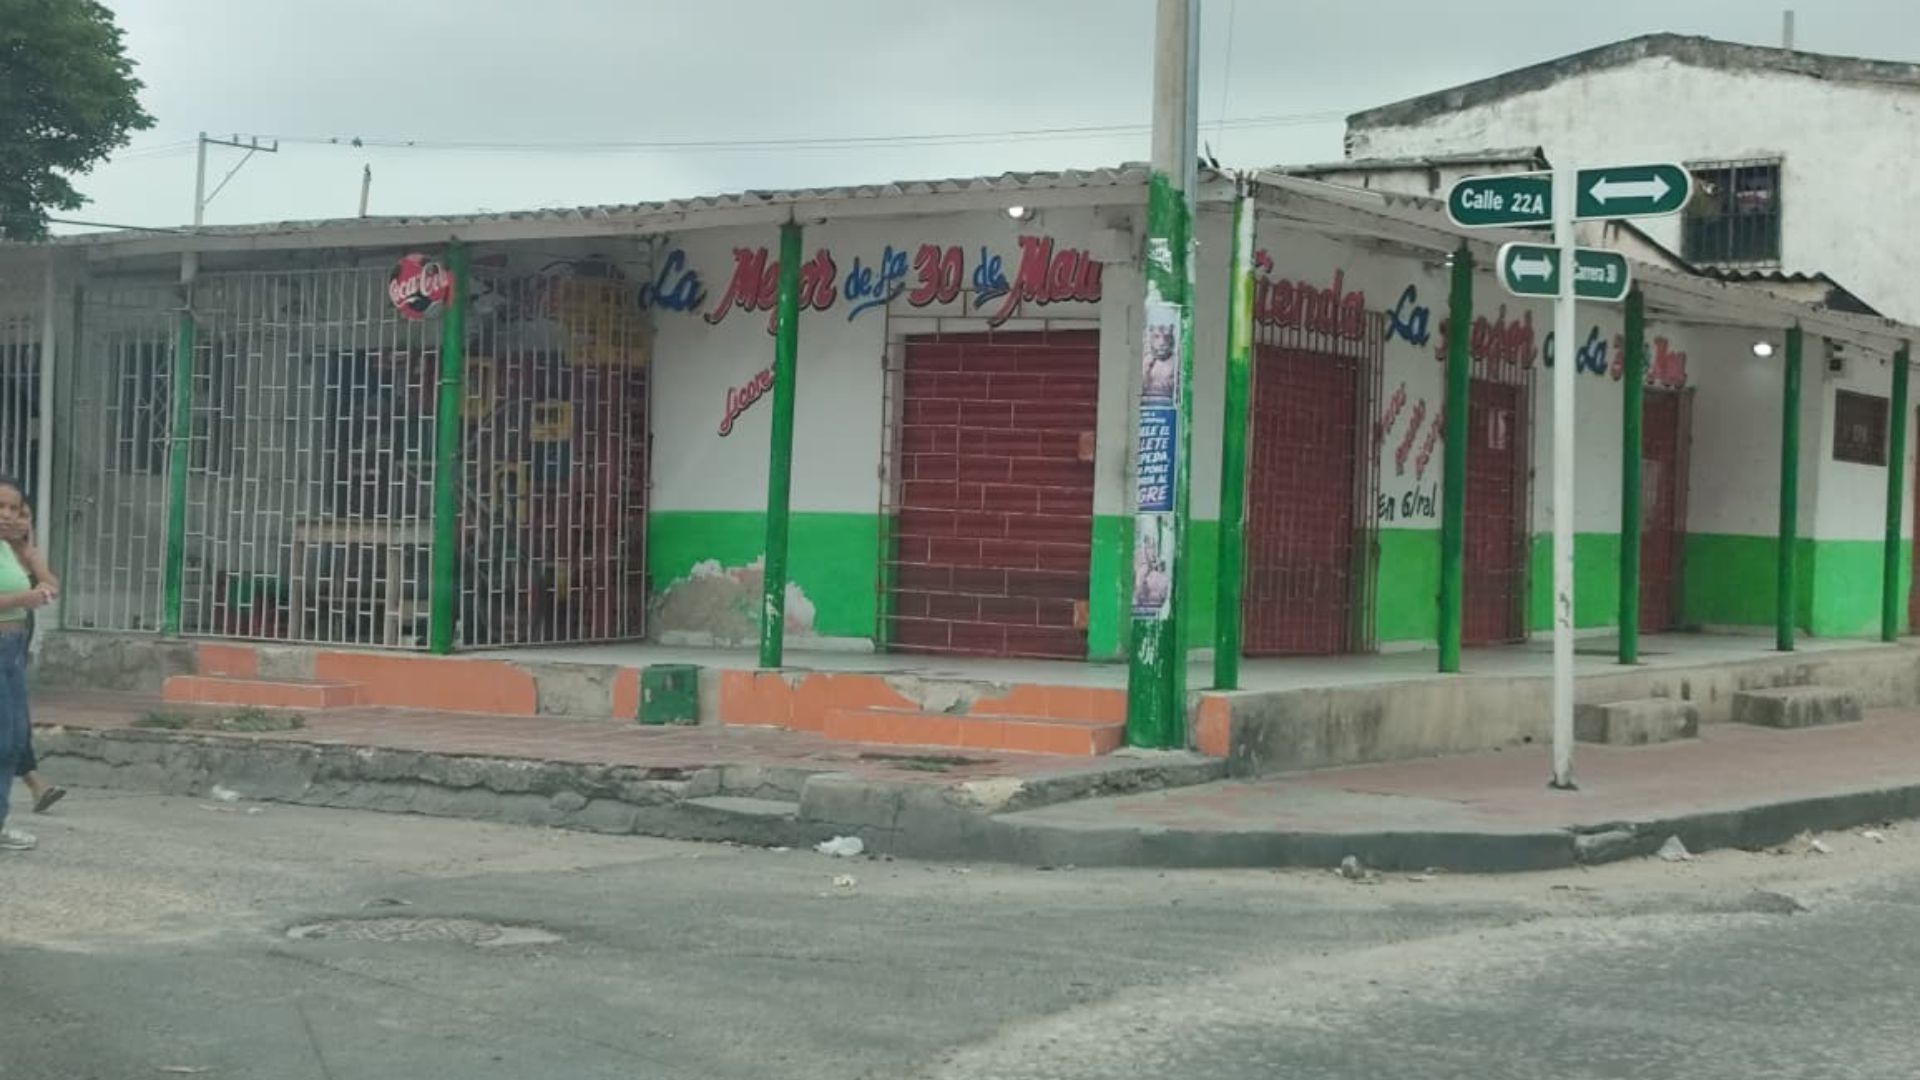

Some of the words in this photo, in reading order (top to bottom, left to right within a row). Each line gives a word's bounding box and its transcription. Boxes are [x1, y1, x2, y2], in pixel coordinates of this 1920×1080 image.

[1461, 188, 1503, 210] Calle
[1511, 192, 1544, 214] 22A
[638, 248, 708, 312] La
[703, 246, 838, 336] Meor
[844, 255, 872, 301] de
[907, 243, 964, 307] 30
[973, 245, 1010, 294] de
[1255, 248, 1366, 340] ienda
[1384, 284, 1430, 346] La
